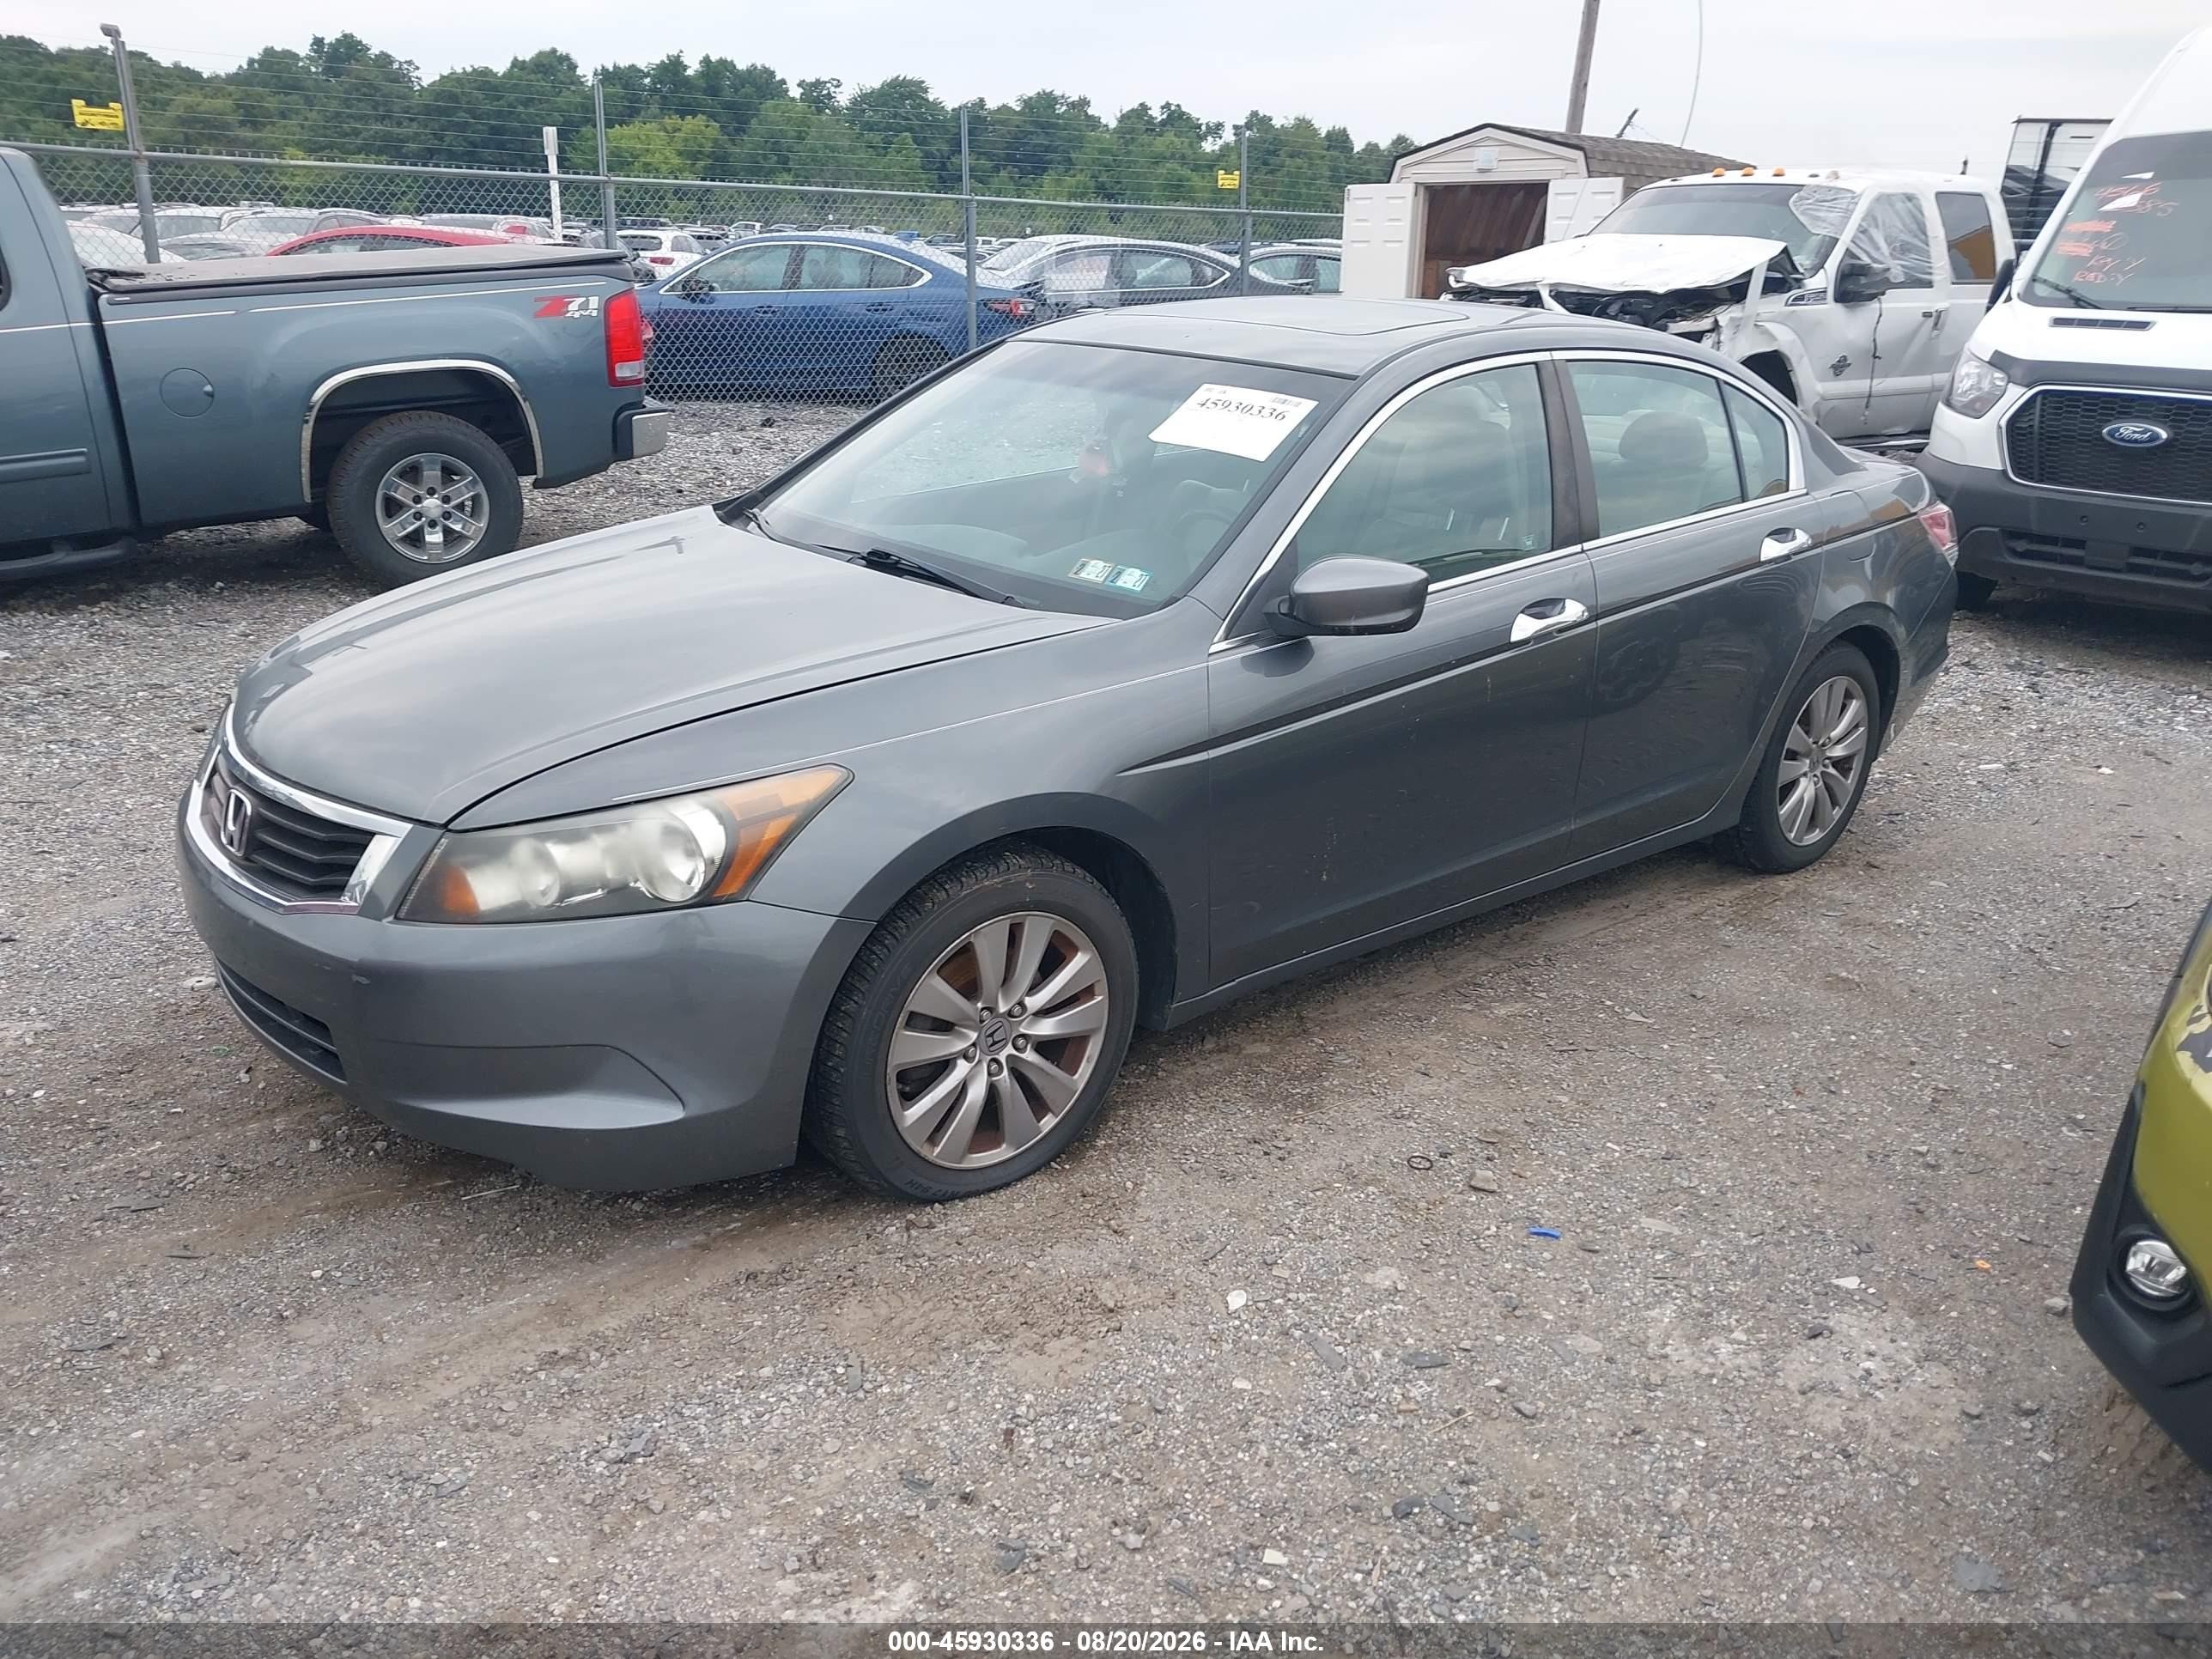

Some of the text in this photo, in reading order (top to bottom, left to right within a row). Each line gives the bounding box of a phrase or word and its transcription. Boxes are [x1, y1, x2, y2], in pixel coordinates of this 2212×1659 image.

[535, 295, 599, 319] Z71
[1196, 397, 1291, 422] 45930336
[2114, 426, 2153, 441] Ford
